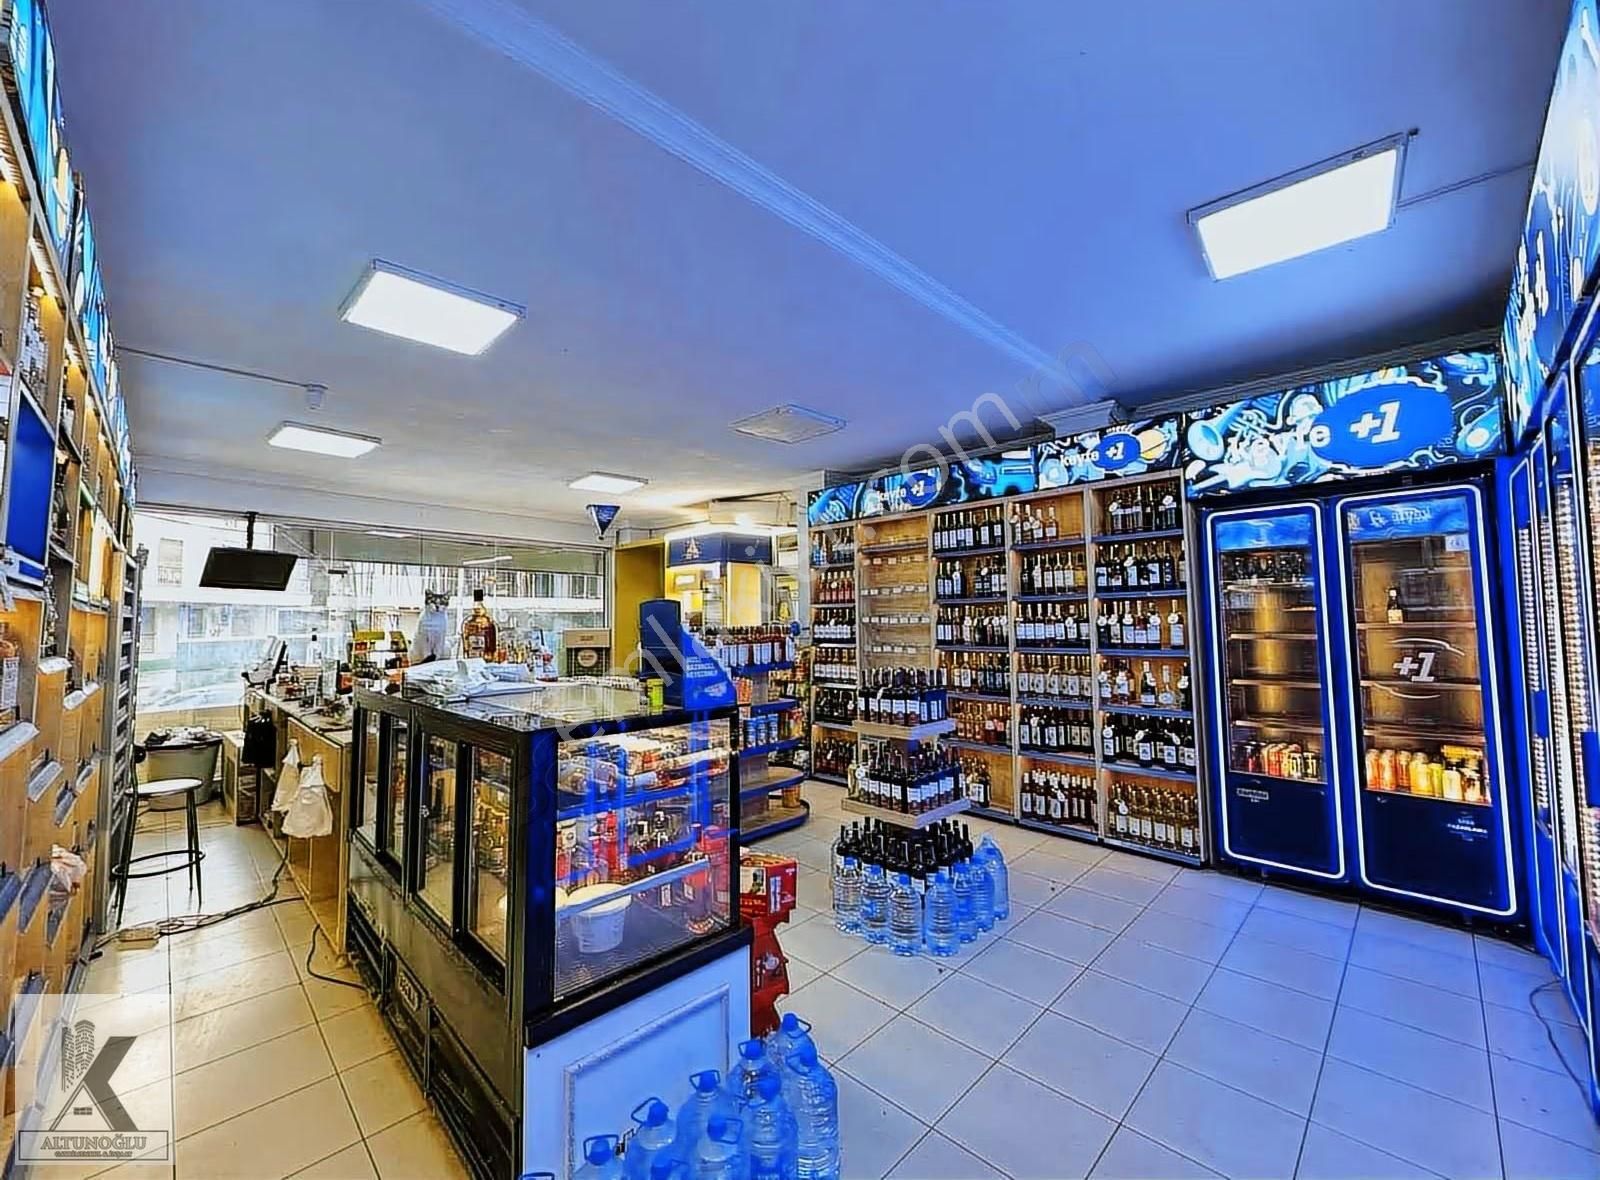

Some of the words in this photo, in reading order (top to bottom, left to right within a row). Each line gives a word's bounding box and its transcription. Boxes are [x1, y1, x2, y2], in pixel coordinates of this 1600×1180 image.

[1349, 401, 1400, 444] +1
[1105, 442, 1124, 460] +1
[911, 480, 925, 497] +1
[1393, 652, 1435, 682] +1
